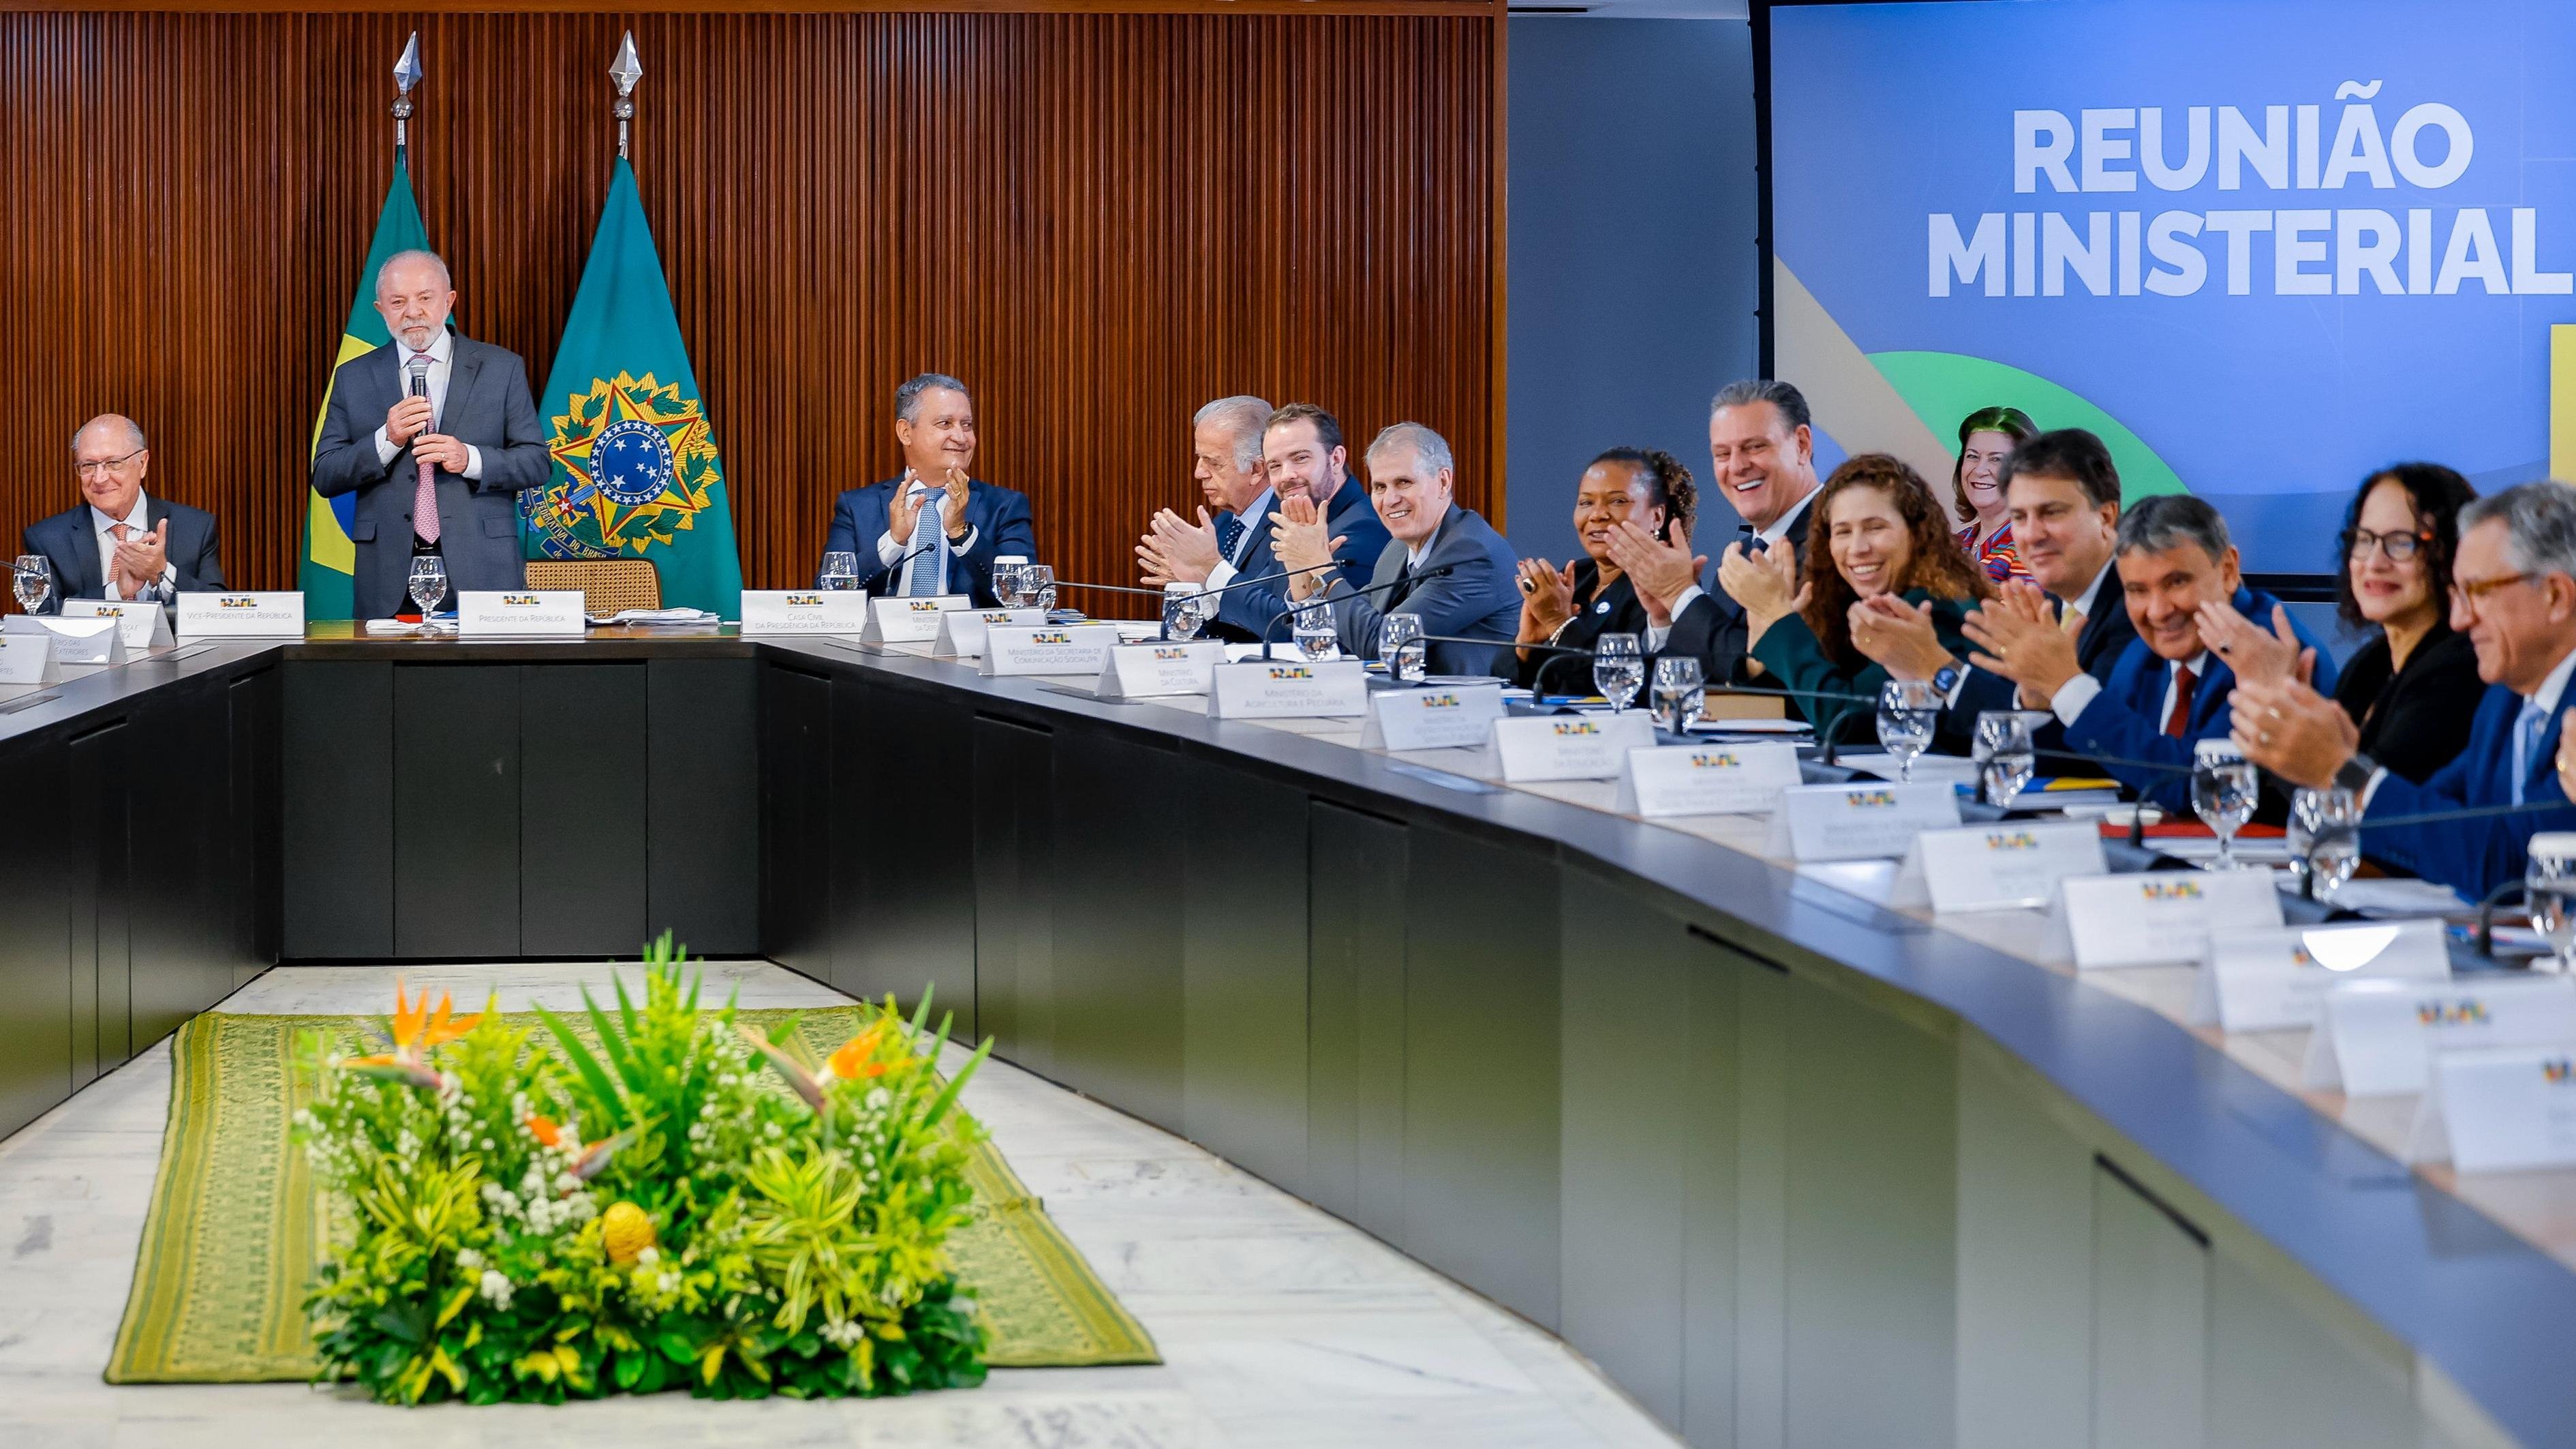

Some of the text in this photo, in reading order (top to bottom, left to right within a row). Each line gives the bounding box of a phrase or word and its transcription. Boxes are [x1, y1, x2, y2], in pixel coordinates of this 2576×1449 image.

[2014, 79, 2474, 193] REUNIÃO
[1928, 207, 2573, 298] MINISTERIAL
[536, 500, 568, 541] FEDERATIVA
[570, 540, 580, 551] DO
[187, 611, 245, 620] VICE-PRESIDENTE
[530, 614, 566, 622] REPÚBLICA
[787, 613, 824, 621] CASA CIVIL
